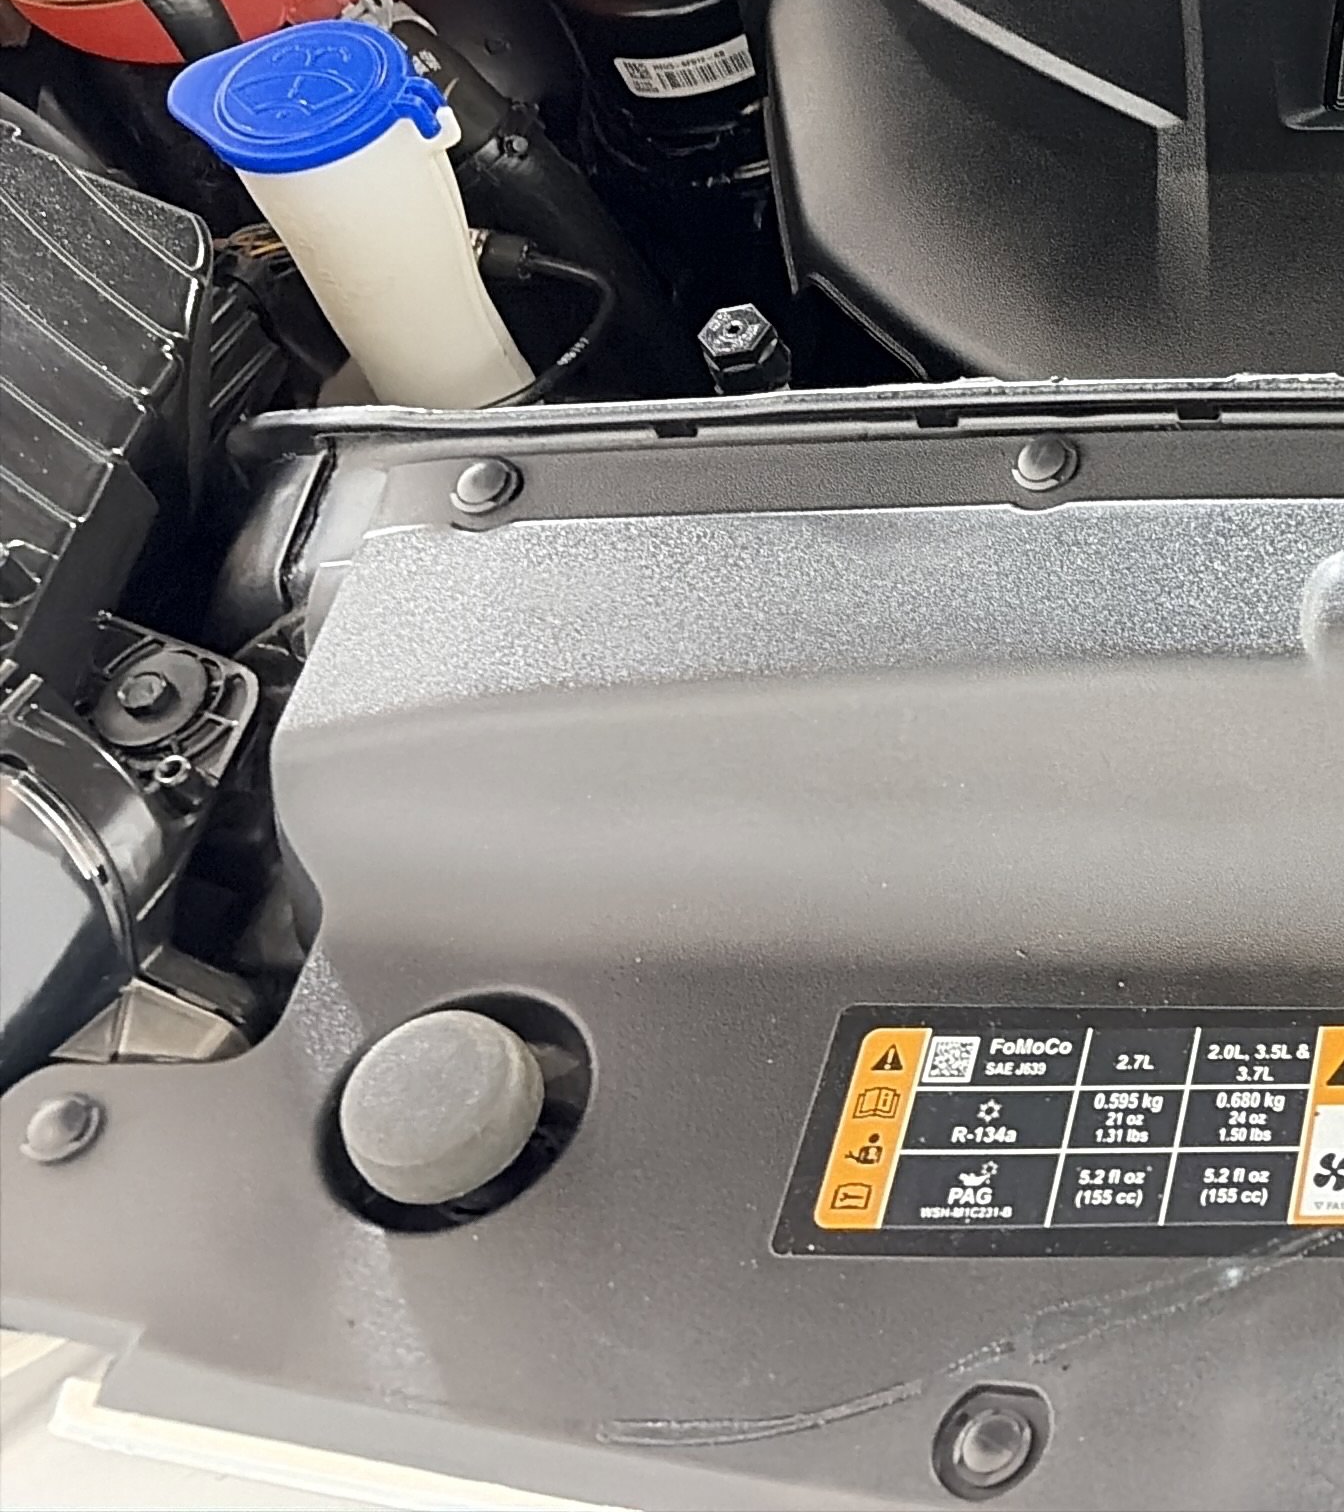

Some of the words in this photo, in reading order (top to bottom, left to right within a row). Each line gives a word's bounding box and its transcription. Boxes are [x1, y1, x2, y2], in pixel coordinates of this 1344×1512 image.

[989, 1037, 1073, 1056] FoMoCo
[1207, 1044, 1250, 1062] 2.0L,
[1253, 1043, 1292, 1060] 3.5L
[1295, 1043, 1311, 1060] &
[984, 1061, 1013, 1076] SAE
[1014, 1061, 1048, 1076] J639
[1115, 1054, 1155, 1071] 2.7L
[1235, 1066, 1275, 1082] 3.7L
[1093, 1092, 1140, 1110] 0.595
[1141, 1092, 1164, 1113] kg
[1216, 1092, 1262, 1109] 0.680
[1263, 1092, 1286, 1112] kg
[1105, 1112, 1123, 1126] 21
[1125, 1113, 1145, 1126] oz
[1228, 1110, 1247, 1125] 24
[1249, 1112, 1268, 1125] oz
[950, 1125, 1018, 1144] R-134a
[1095, 1128, 1122, 1143] 1.31
[1126, 1128, 1149, 1143] lbs
[1218, 1127, 1247, 1142] 1.50
[1249, 1127, 1272, 1142] lbs
[1078, 1169, 1106, 1185] 5.2
[1108, 1169, 1121, 1185] fl
[1123, 1171, 1146, 1185] oz
[1203, 1167, 1230, 1184] 5.2
[1232, 1167, 1246, 1183] fl
[1248, 1170, 1271, 1184] oz
[947, 1187, 993, 1205] PAG
[1074, 1189, 1113, 1208] (155
[1115, 1189, 1143, 1208] cc)
[1200, 1188, 1238, 1207] (155
[1240, 1188, 1268, 1207] cc)
